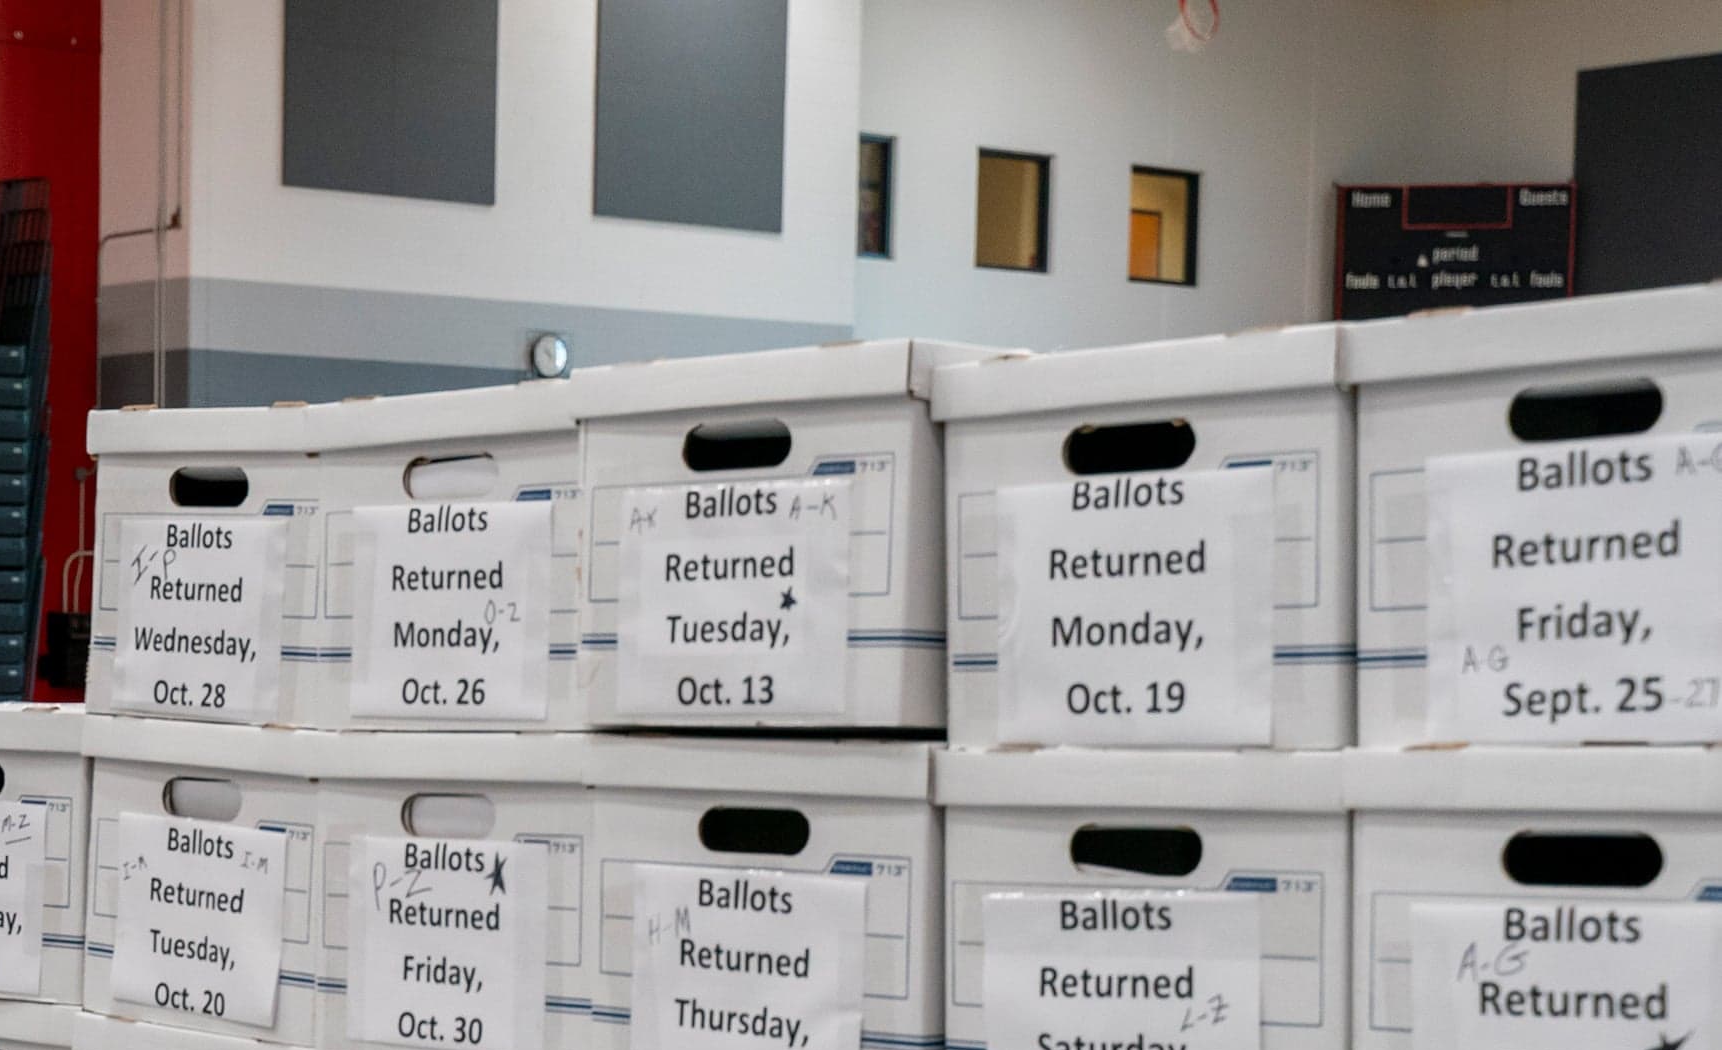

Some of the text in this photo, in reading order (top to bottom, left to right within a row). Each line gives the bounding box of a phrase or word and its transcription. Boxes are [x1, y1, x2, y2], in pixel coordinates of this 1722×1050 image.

[1351, 192, 1392, 208] Home
[1433, 245, 1478, 264] period
[1432, 273, 1478, 290] player
[1518, 451, 1653, 491] Ballots
[686, 488, 777, 519] Ballots
[1073, 479, 1183, 510] Ballots
[408, 505, 487, 533] Ballots
[167, 523, 232, 549] Ballots
[1493, 519, 1680, 568] Returned
[393, 561, 502, 590] Returned
[666, 546, 793, 581] Returned
[1050, 540, 1205, 579] Returned
[151, 576, 242, 602] Returned
[394, 619, 499, 654] Monday,
[667, 612, 789, 648] Tuesday,
[1052, 612, 1203, 651] Monday,
[1518, 602, 1651, 644] Friday,
[135, 627, 255, 662] Wednesday,
[154, 680, 225, 708] Oct. 28
[402, 678, 485, 705] Oct. 26
[678, 675, 773, 706] Oct. 13
[1067, 681, 1185, 714] Oct. 19
[1504, 677, 1663, 723] Sept. 25
[168, 828, 233, 859] Ballots
[405, 843, 484, 875] Ballots
[150, 878, 244, 913] Returned
[699, 879, 792, 914] Ballots
[390, 898, 499, 930] Returned
[1060, 899, 1172, 930] Ballots
[1504, 907, 1641, 943] Ballots
[150, 929, 234, 970] Tuesday,
[681, 939, 809, 978] Returned
[404, 956, 482, 992] Friday,
[1040, 966, 1193, 999] Returned
[155, 983, 225, 1017] Oct. 20
[1480, 981, 1667, 1020] Returned
[399, 1012, 482, 1045] Oct. 30
[675, 998, 808, 1048] Thursday,
